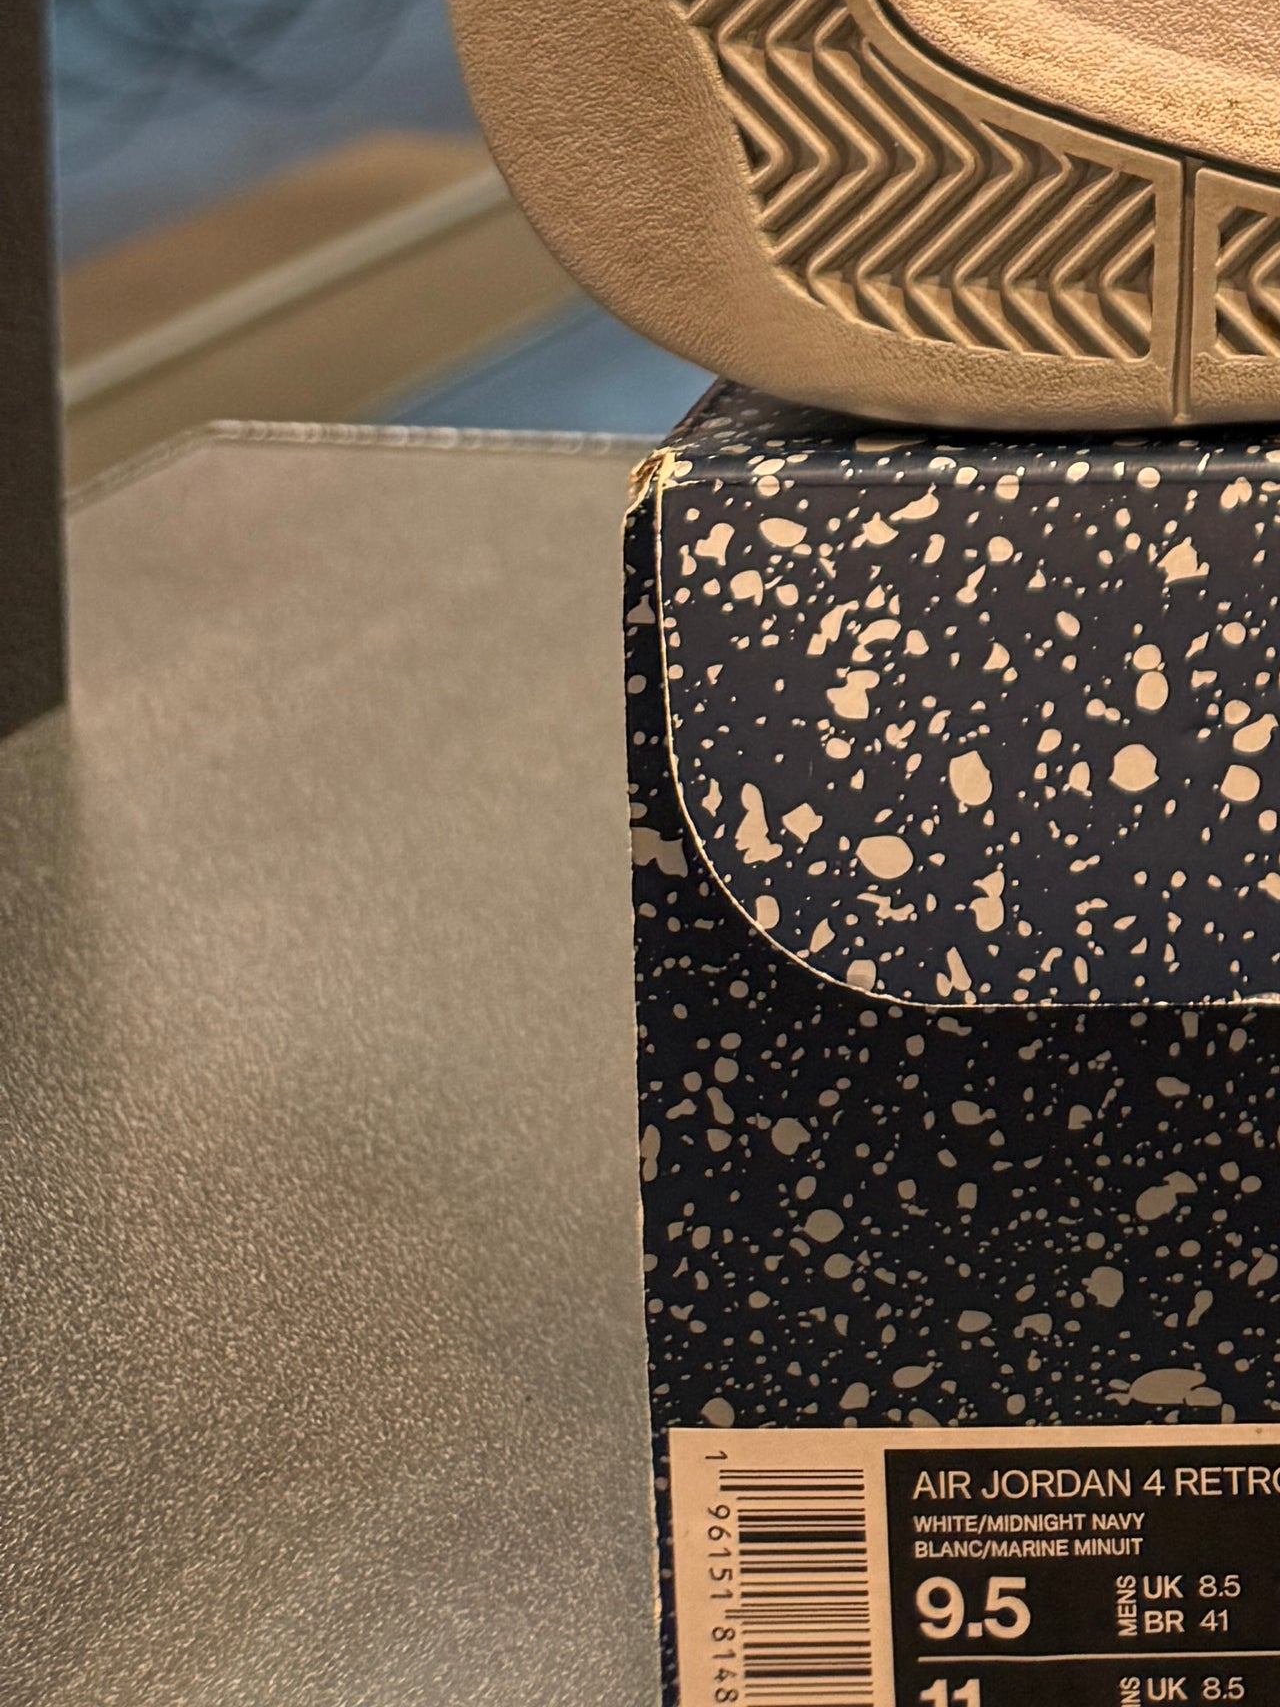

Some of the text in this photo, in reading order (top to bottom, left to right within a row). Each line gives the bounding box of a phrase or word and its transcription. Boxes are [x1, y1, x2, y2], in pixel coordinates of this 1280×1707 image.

[912, 1470, 972, 1500] AIR
[981, 1468, 1131, 1499] JORDAN
[1143, 1468, 1166, 1496] 4
[913, 1512, 1145, 1533] WHITE/MIDNIGHT NAVY
[707, 1504, 734, 1600] 96151
[915, 1537, 1144, 1559] BLANC/MARINE MINUIT
[1143, 1576, 1183, 1600] UK
[1199, 1574, 1242, 1599] 8.5
[915, 1576, 1031, 1640] 9.5
[1116, 1574, 1138, 1636] MENS
[1143, 1610, 1184, 1633] BR
[1199, 1609, 1230, 1632] 41
[712, 1626, 739, 1704] 8148
[1146, 1677, 1188, 1701] UK
[1202, 1676, 1246, 1700] 8.5
